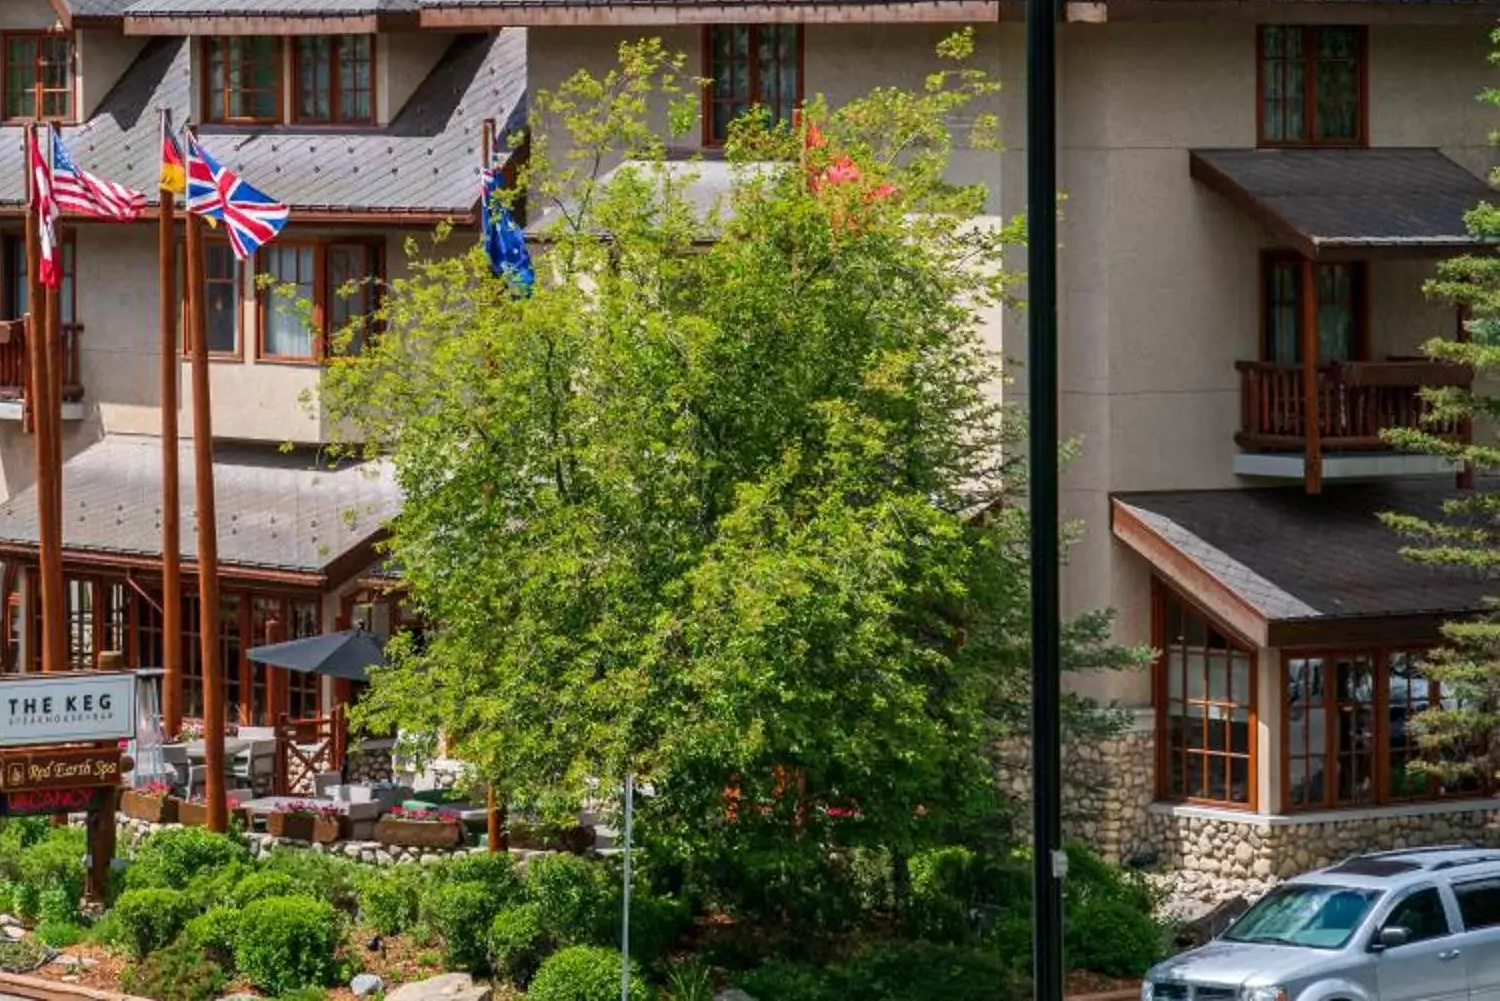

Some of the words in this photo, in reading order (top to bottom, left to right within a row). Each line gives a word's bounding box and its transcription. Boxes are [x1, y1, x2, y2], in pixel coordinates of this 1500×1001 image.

[8, 697, 52, 715] THE
[66, 694, 111, 712] KEG
[29, 761, 53, 780] Red
[53, 759, 91, 778] Earth
[93, 760, 117, 780] Spa
